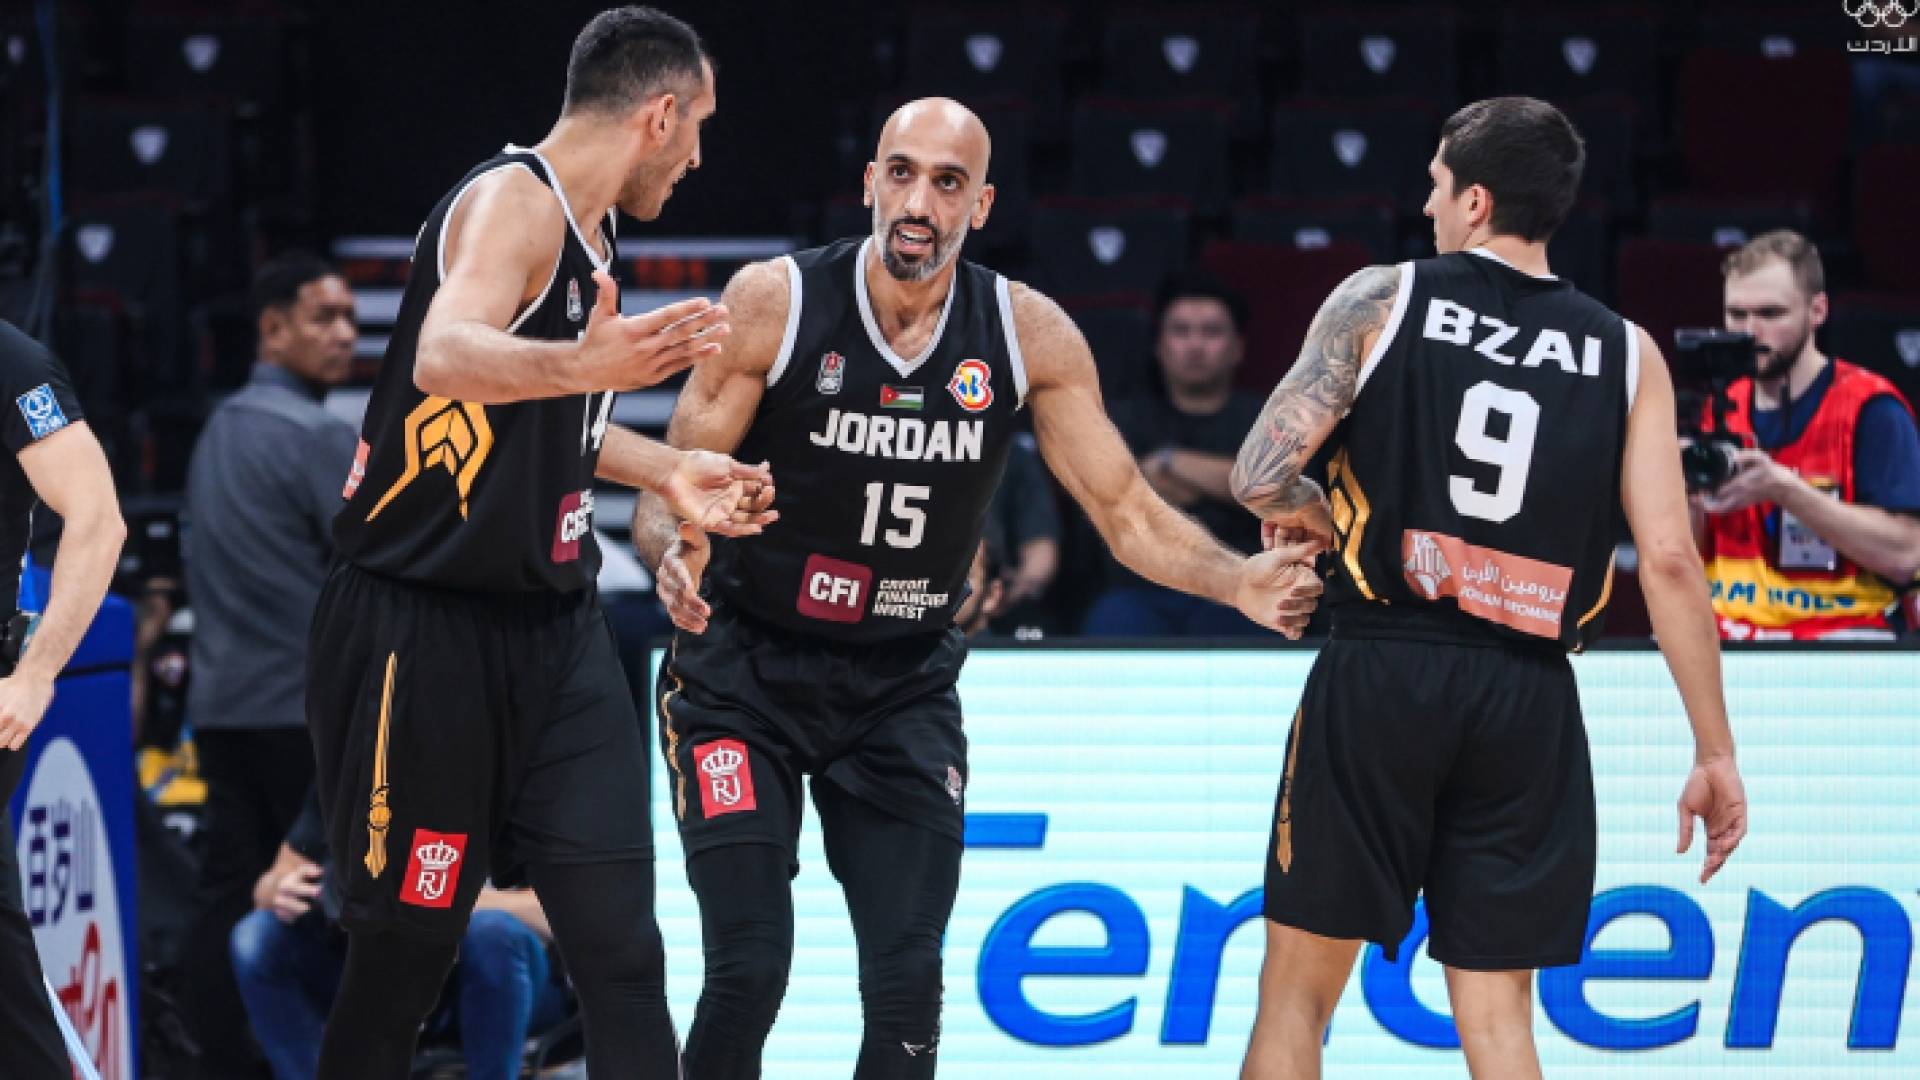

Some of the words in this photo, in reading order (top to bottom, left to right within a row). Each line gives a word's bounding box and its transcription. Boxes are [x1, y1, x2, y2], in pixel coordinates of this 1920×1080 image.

[1422, 296, 1602, 377] BZAI
[809, 407, 984, 462] JORDAN
[1448, 380, 1541, 524] 9
[860, 481, 932, 549] 15
[808, 571, 861, 608] CFI
[963, 811, 1920, 1050] encen
